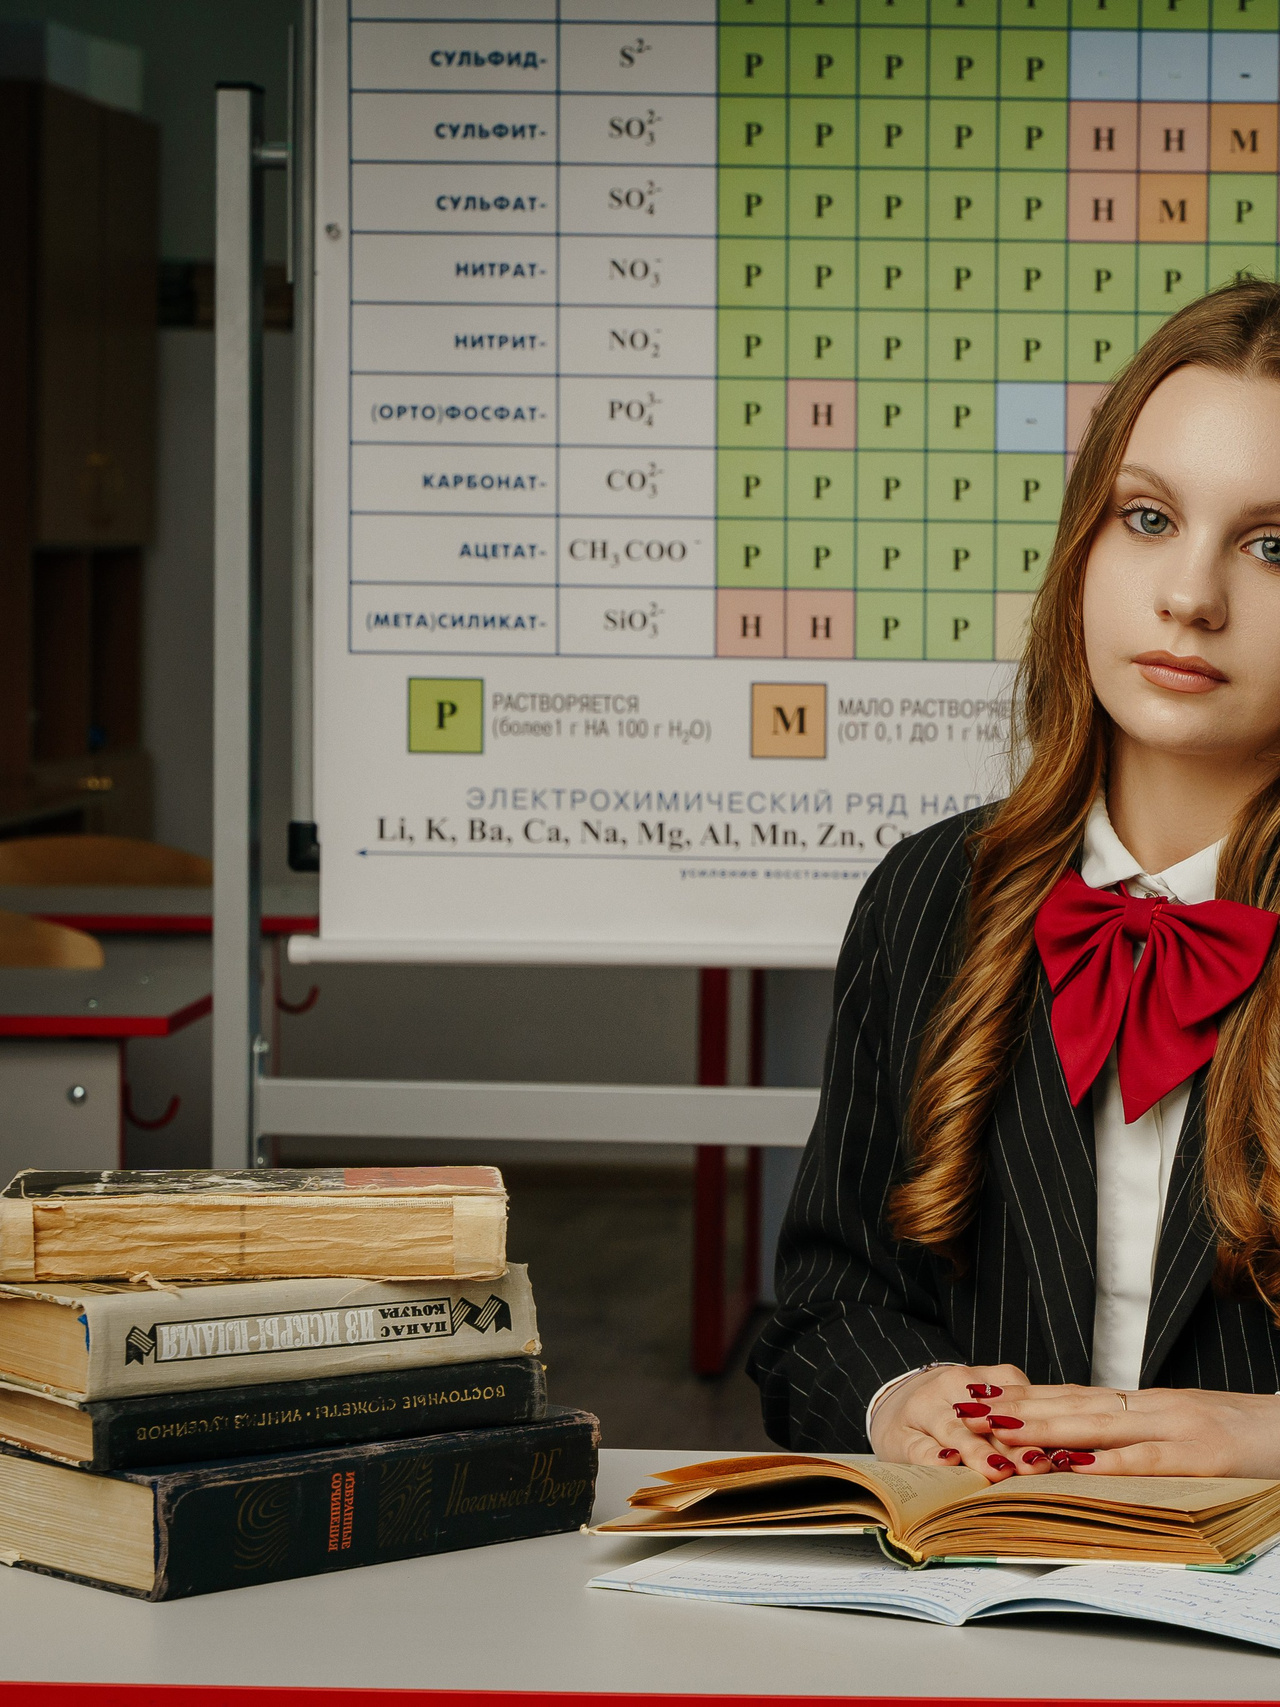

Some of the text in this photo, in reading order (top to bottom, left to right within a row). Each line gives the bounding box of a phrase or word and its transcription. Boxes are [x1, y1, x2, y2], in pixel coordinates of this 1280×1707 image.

[429, 48, 547, 70] СУЛЬФИД-
[434, 121, 547, 141] СУЛЬФИТ-
[435, 193, 547, 213] СУЛЬФАТ-
[455, 261, 546, 278] НИТРАТ-
[454, 333, 546, 350] НИТРИТ-
[422, 473, 546, 491] КАРБОНАТ-
[459, 542, 546, 561] АЦЕТАТ-
[466, 786, 833, 815] ЭЛЕКТРОХИМИЧЕСКИЙ
[846, 792, 909, 819] РЯД
[378, 817, 414, 844] Li,
[427, 818, 456, 845] K,
[469, 819, 512, 846] Ba,
[523, 820, 569, 846] Ca,
[582, 820, 627, 847] Na,
[638, 821, 691, 852] Mg,
[703, 823, 739, 849] Al,
[750, 823, 806, 849] Mn,
[818, 824, 864, 851] Zn,
[378, 1301, 447, 1319] КОЧУРА
[380, 1319, 448, 1339] ПАНАС
[402, 1383, 506, 1410] ВОСТОЧНЫЕ
[314, 1396, 397, 1421] СЮЖЕТЫ
[327, 1471, 343, 1553] СОЧИНЕНИЯ
[340, 1469, 356, 1551] ИЗБРАННЫЕ
